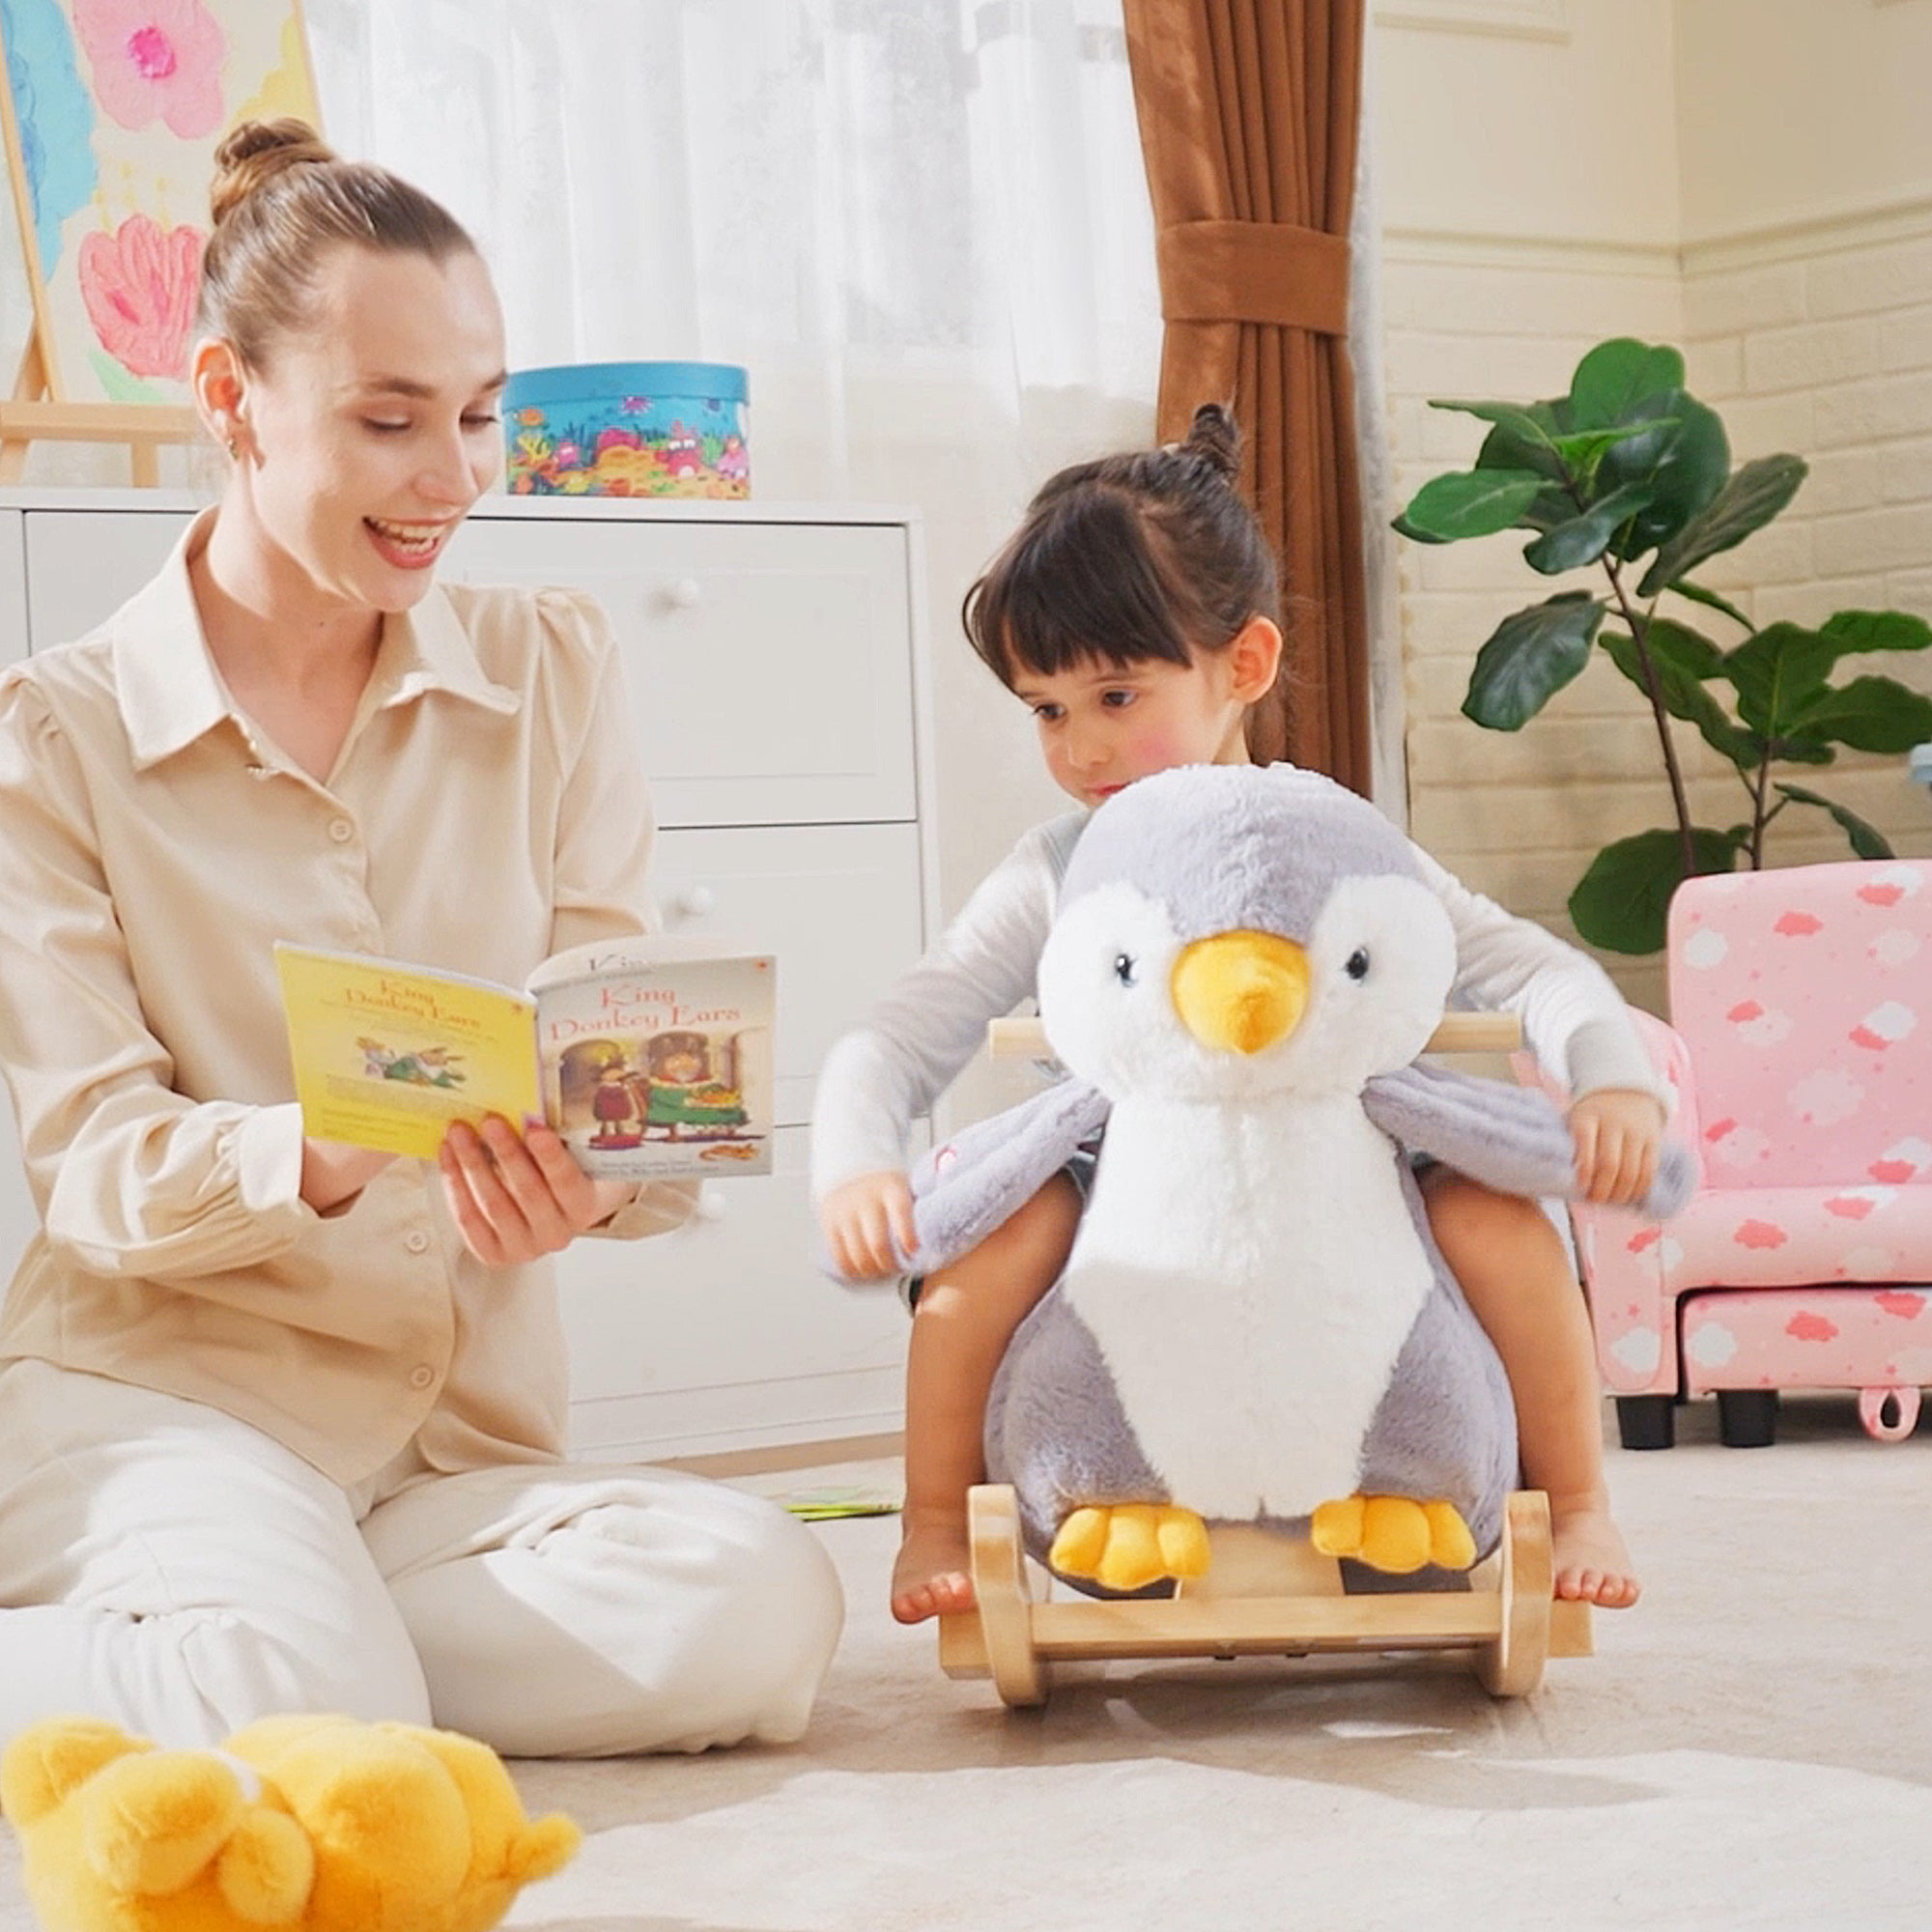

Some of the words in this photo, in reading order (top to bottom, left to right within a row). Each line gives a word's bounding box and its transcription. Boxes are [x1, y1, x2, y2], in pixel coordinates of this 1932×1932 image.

[600, 984, 676, 1008] King
[550, 1009, 660, 1040] Donkey
[668, 1005, 742, 1028] Ears
